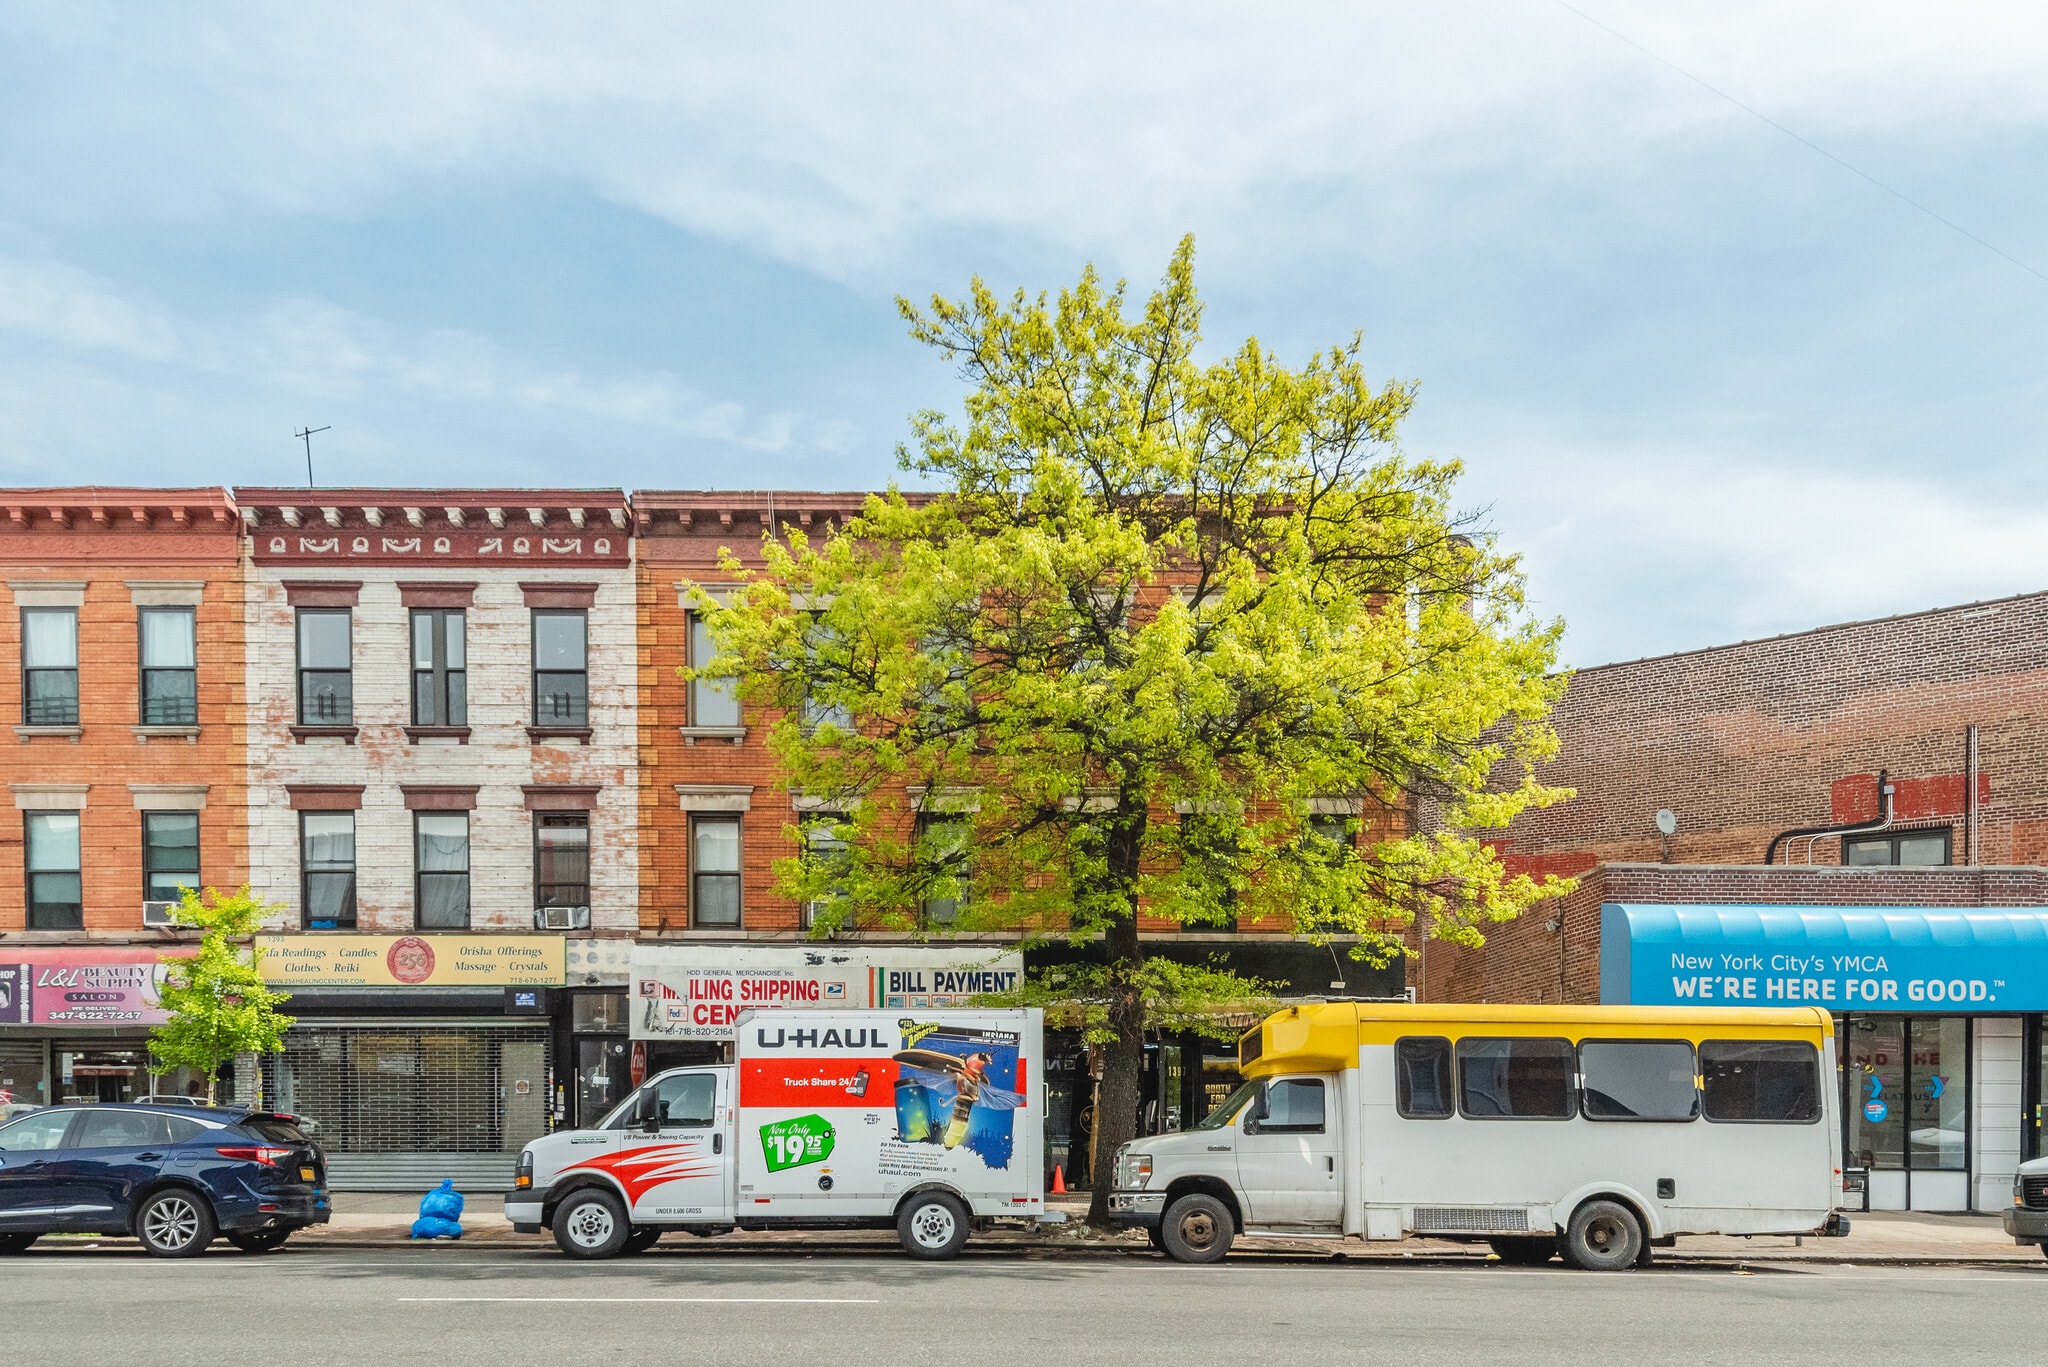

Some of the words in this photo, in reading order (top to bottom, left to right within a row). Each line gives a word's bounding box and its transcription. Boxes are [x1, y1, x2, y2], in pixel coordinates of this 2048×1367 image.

[281, 947, 327, 959] Readings
[339, 947, 378, 958] Candles
[459, 945, 492, 956] Orisha
[497, 945, 543, 957] Offerings
[398, 952, 426, 970] 256
[454, 961, 497, 973] Massage
[508, 961, 549, 973] Crystals
[1671, 952, 1713, 970] New
[1721, 953, 1763, 971] York
[1771, 953, 1825, 975] City's
[1831, 955, 1889, 972] YMCA
[284, 962, 321, 973] Clothes
[334, 962, 360, 973] Reiki
[686, 969, 701, 977] HDD
[703, 969, 733, 977] GENERAL
[736, 969, 782, 977] MERCHANDISE
[37, 968, 80, 988] L&L
[84, 967, 148, 978] BEAUTY
[84, 978, 147, 989] SUPPLY
[265, 977, 366, 985] WWW.256HEALINGCENTER.COM
[889, 971, 927, 993] BILL
[934, 971, 1017, 993] PAYMENT
[663, 979, 733, 1001] MILING
[740, 979, 820, 1001] SHIPPING
[1672, 975, 1757, 999] WE'RE
[1766, 978, 1836, 1001] HERE
[1845, 979, 1899, 1002] FOR
[48, 1011, 142, 1020] 347-622-7247
[907, 1025, 939, 1051] America
[982, 1031, 1016, 1040] INDIANA
[783, 1077, 809, 1086] Truck
[810, 1077, 837, 1086] Share
[838, 1076, 861, 1087] 24/7
[1205, 1084, 1231, 1094] BOOTH
[1210, 1094, 1226, 1104] FOR
[768, 1124, 786, 1135] Now
[788, 1123, 811, 1137] Only
[878, 1168, 922, 1177] uhaul.com
